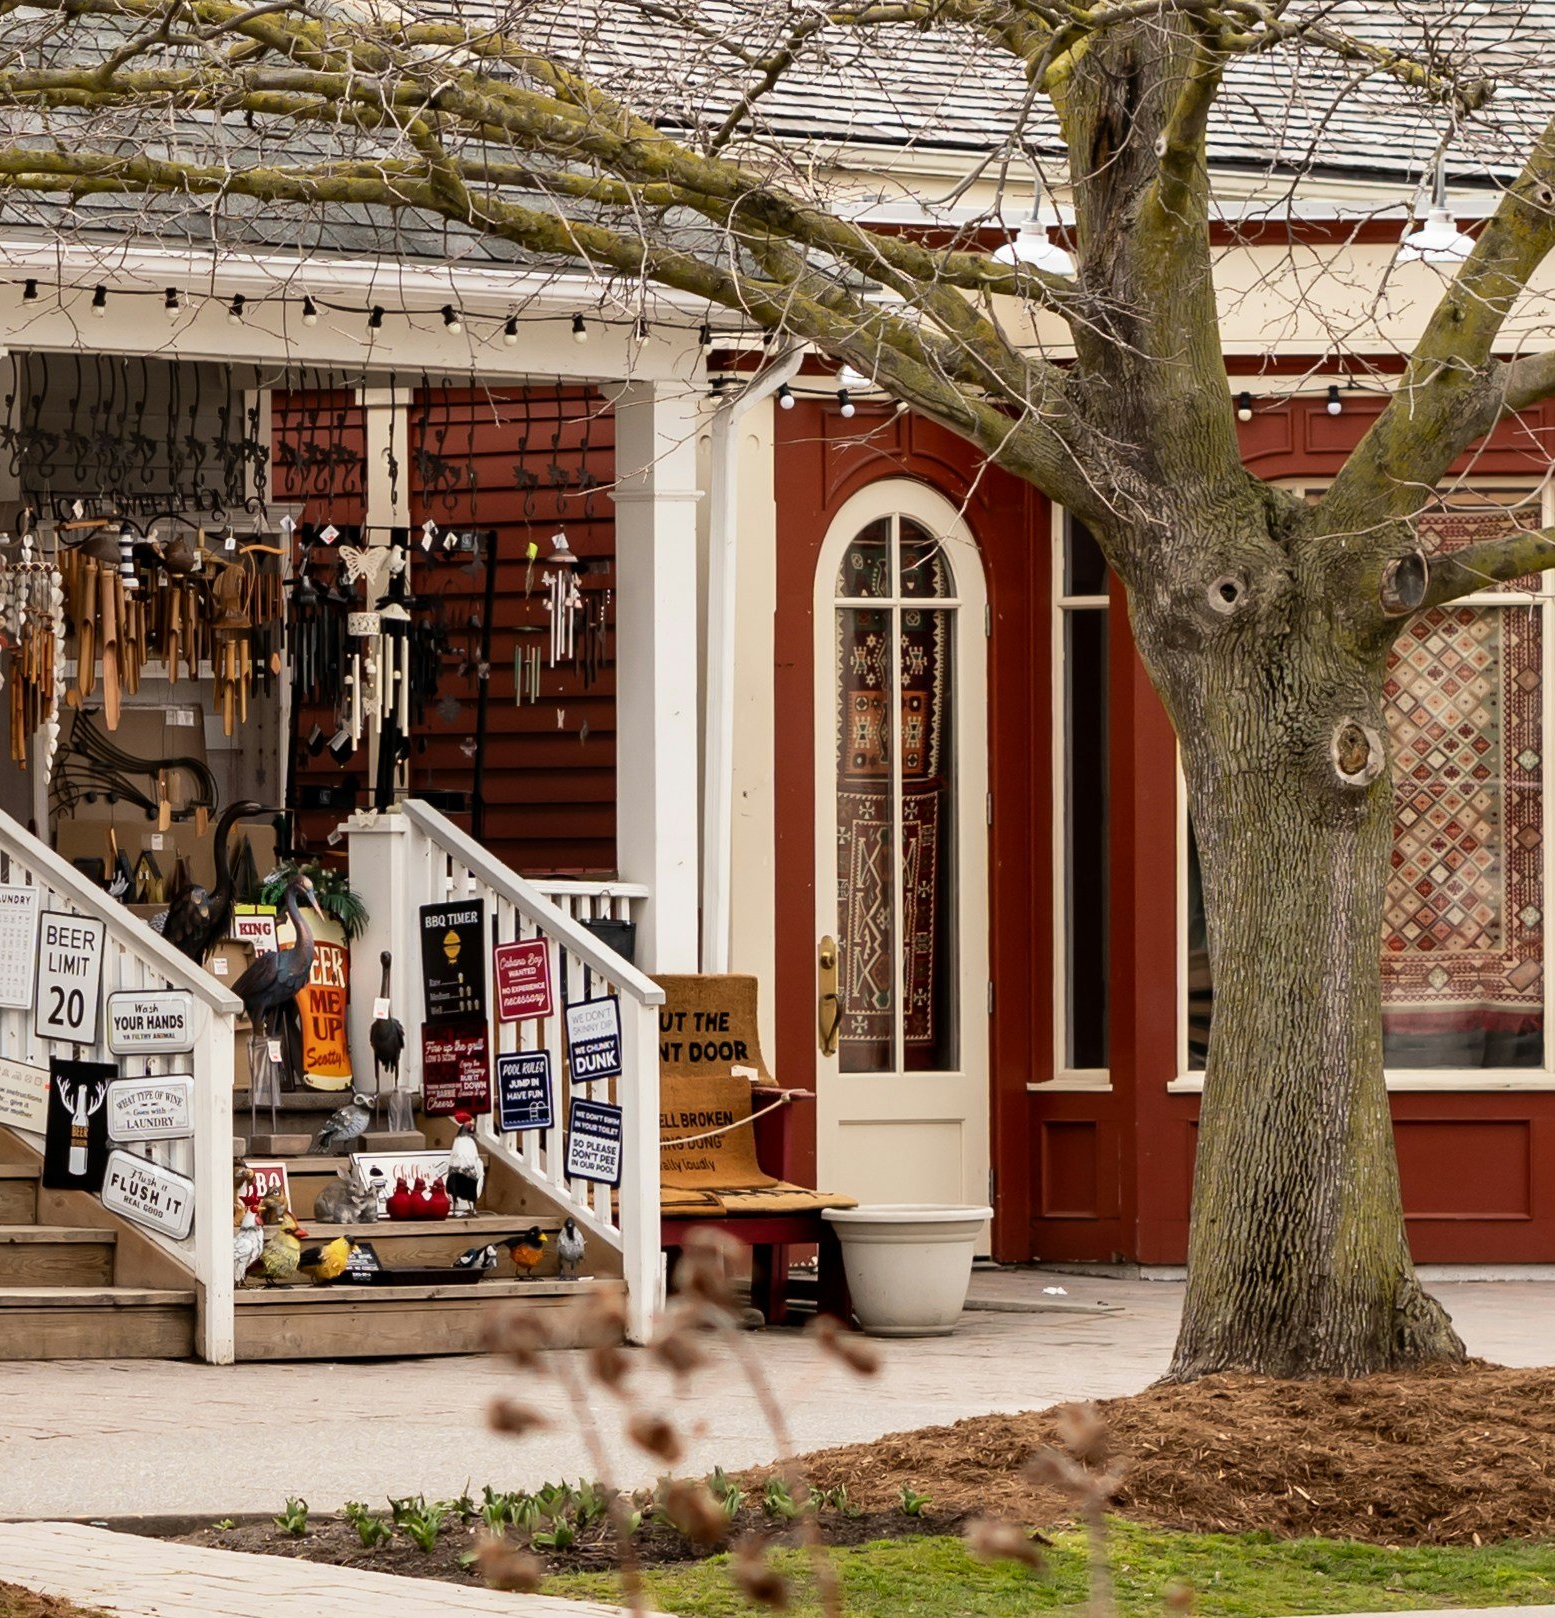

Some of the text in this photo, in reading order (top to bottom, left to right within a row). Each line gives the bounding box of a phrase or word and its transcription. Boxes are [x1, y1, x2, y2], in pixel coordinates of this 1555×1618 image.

[425, 911, 478, 928] BBQ TIMER
[238, 923, 271, 936] KING
[46, 925, 96, 952] BEER
[48, 952, 91, 977] LIMIT
[310, 946, 346, 989] EER
[500, 953, 543, 970] Cabana Boy
[508, 967, 536, 978] WANTED
[511, 982, 545, 993] EXPERIENCE
[48, 985, 85, 1028] 20
[310, 989, 343, 1016] ME
[504, 993, 545, 1006] necessary
[134, 1003, 159, 1014] Wash
[572, 1008, 611, 1024] WE DON'T
[114, 1014, 184, 1031] YOUR HANDS
[313, 1016, 343, 1041] UP
[573, 1020, 613, 1036] SKINNY DIP
[694, 1012, 730, 1032] THE
[575, 1040, 614, 1055] WE CHUNKY
[689, 1041, 749, 1062] DOOR
[503, 1061, 544, 1075] POOL RULES
[576, 1051, 617, 1074] DUNK
[464, 1081, 487, 1089] DOWN
[509, 1078, 539, 1089] JUMP IN
[6, 1088, 43, 1103] instructions
[116, 1090, 184, 1110] WHAT TYPE OF WINE
[507, 1089, 543, 1100] HAVE FUN
[151, 1107, 166, 1115] with
[426, 1096, 455, 1110] Cheers
[126, 1117, 174, 1129] LAUNDRY
[576, 1110, 586, 1118] WE
[587, 1112, 603, 1121] DON'T
[680, 1111, 733, 1127] BROKEN
[581, 1122, 597, 1131] YOUR
[597, 1124, 618, 1135] TOILET
[573, 1139, 616, 1155] SO PLEASE
[572, 1149, 615, 1166] DON'T PEE
[682, 1158, 716, 1172] loudly
[571, 1158, 615, 1175] IN OUR POOL
[111, 1173, 182, 1214] FLUSH IT
[123, 1195, 164, 1219] REAL GOOD
